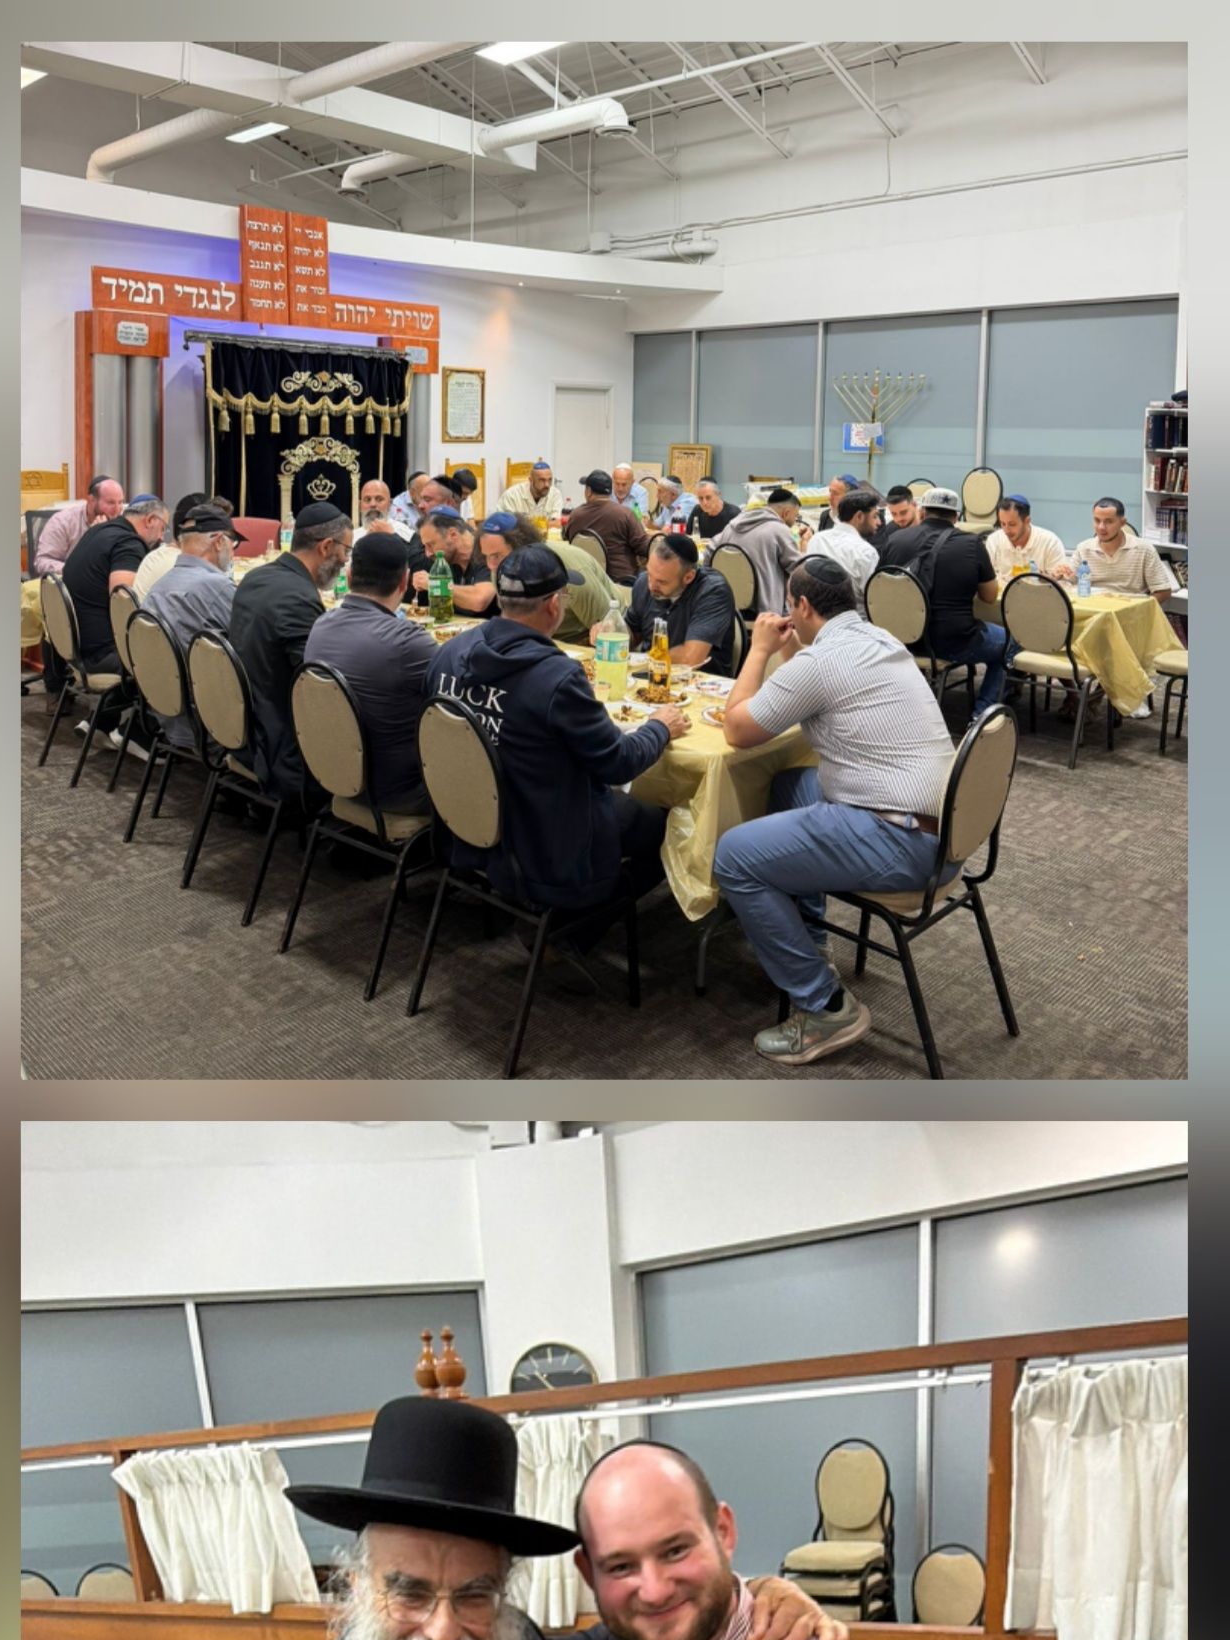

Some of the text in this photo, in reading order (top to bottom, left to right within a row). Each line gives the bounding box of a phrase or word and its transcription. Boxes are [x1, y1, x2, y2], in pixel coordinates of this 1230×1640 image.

[100, 275, 434, 331] שויתי יהוה לנגדי תמיד
[437, 672, 508, 714] LUCK
